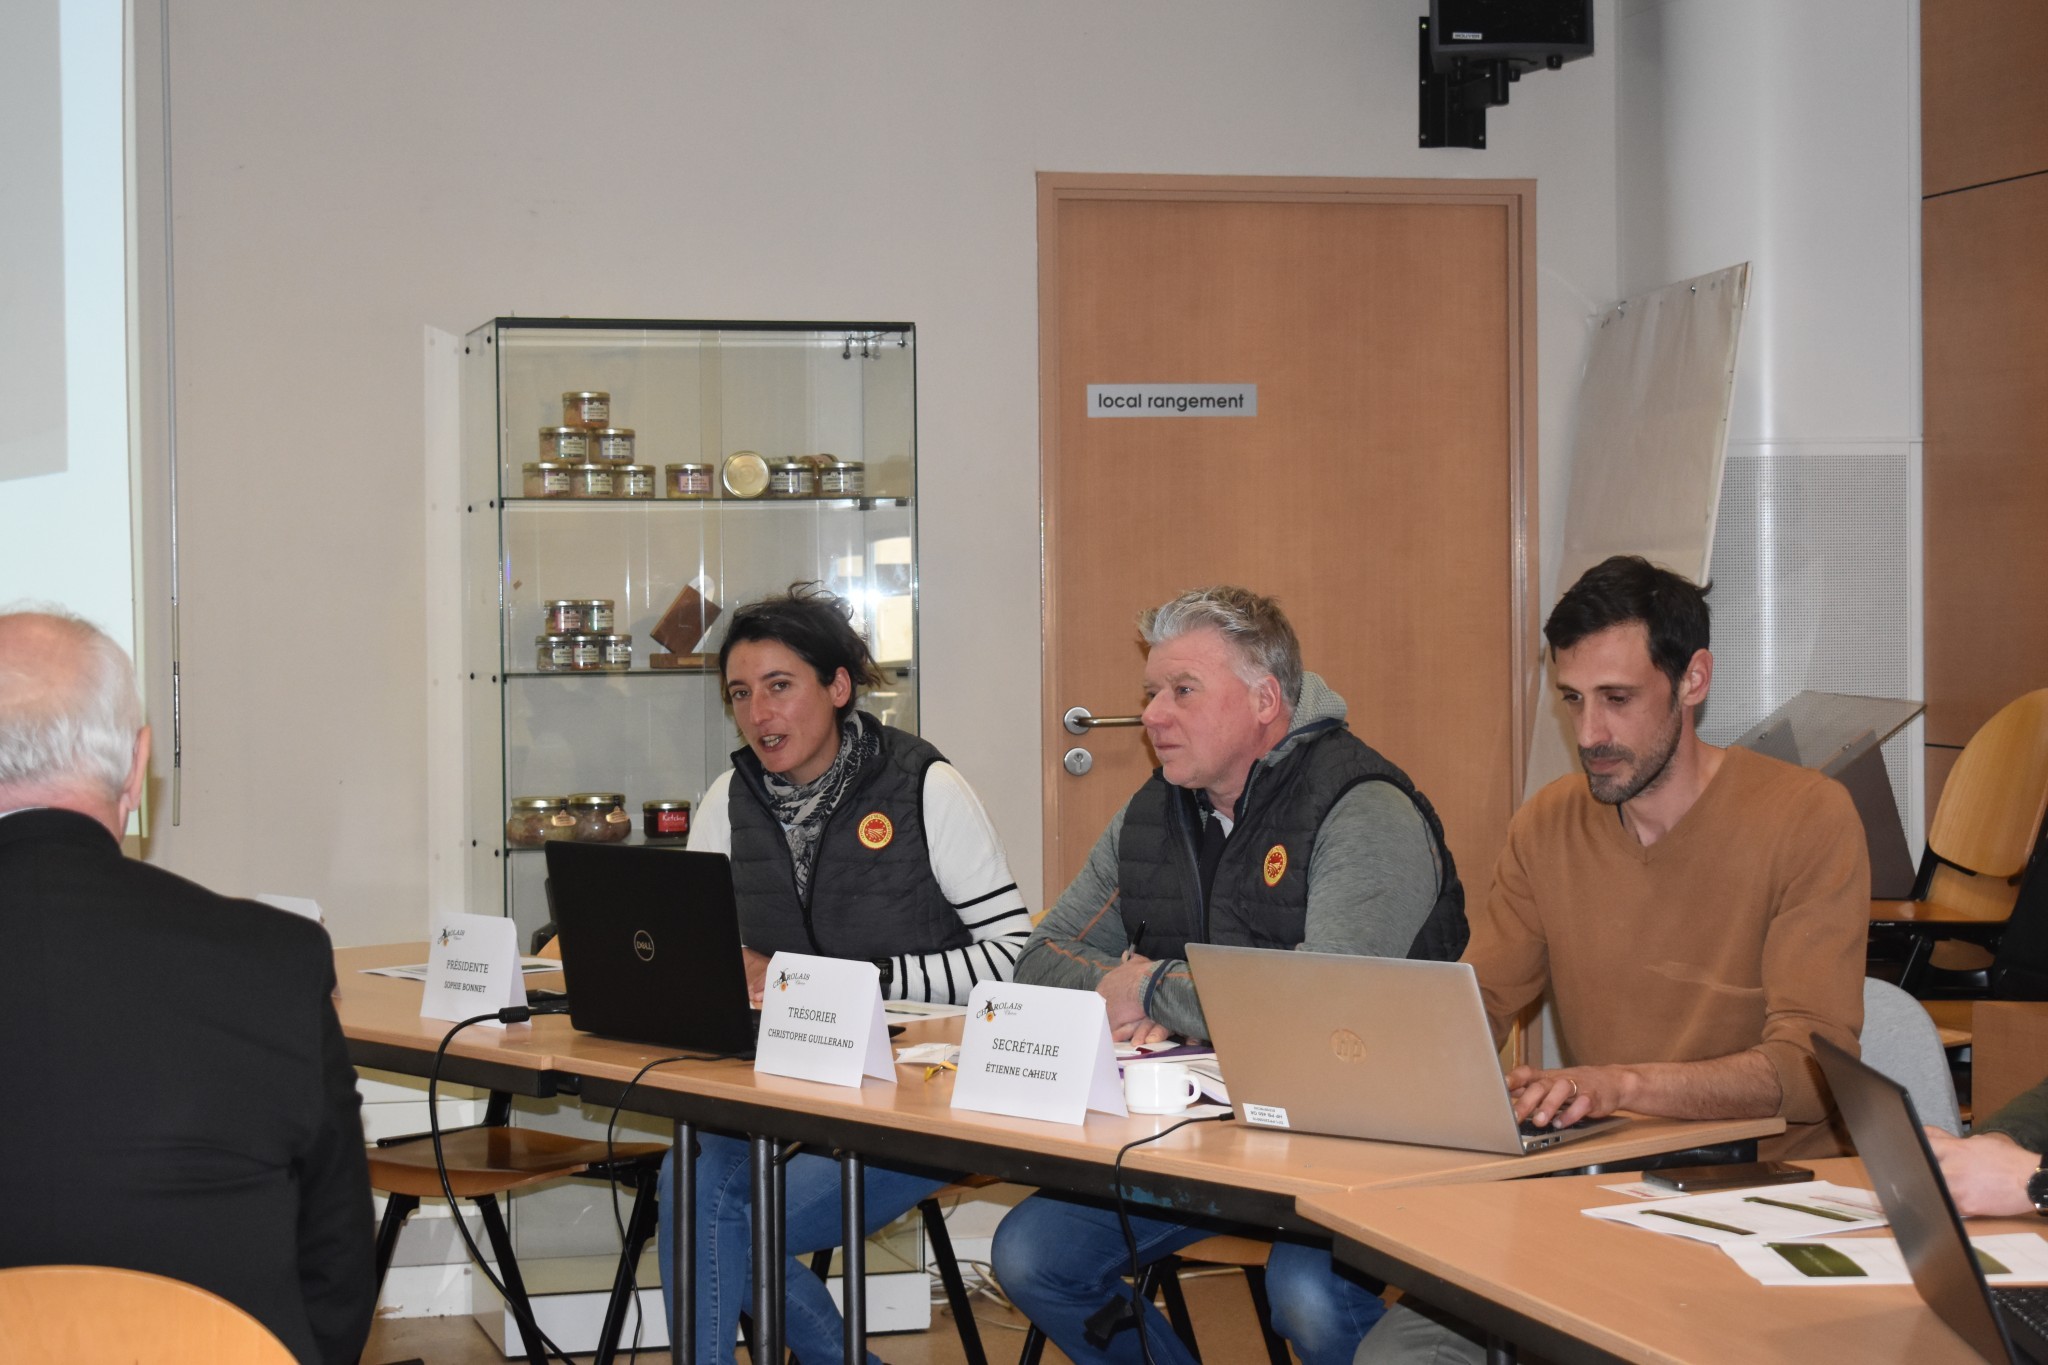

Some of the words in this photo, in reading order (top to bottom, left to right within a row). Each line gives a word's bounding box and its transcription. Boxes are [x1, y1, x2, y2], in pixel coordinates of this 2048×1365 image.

[1098, 393, 1142, 408] local
[1147, 393, 1244, 412] rangement
[636, 940, 653, 951] DELL
[446, 958, 489, 974] PRÉSIDENTE
[444, 980, 461, 991] SOPHIE
[462, 983, 487, 993] BONNET
[788, 1005, 837, 1024] TRÉSORIER
[768, 1028, 807, 1042] CHRISTOPHE
[808, 1035, 854, 1049] GUILLERAND
[992, 1037, 1060, 1057] SECRÉTAIRE
[985, 1061, 1021, 1076] ÉTIENNE
[1022, 1068, 1058, 1081] CAHEUX
